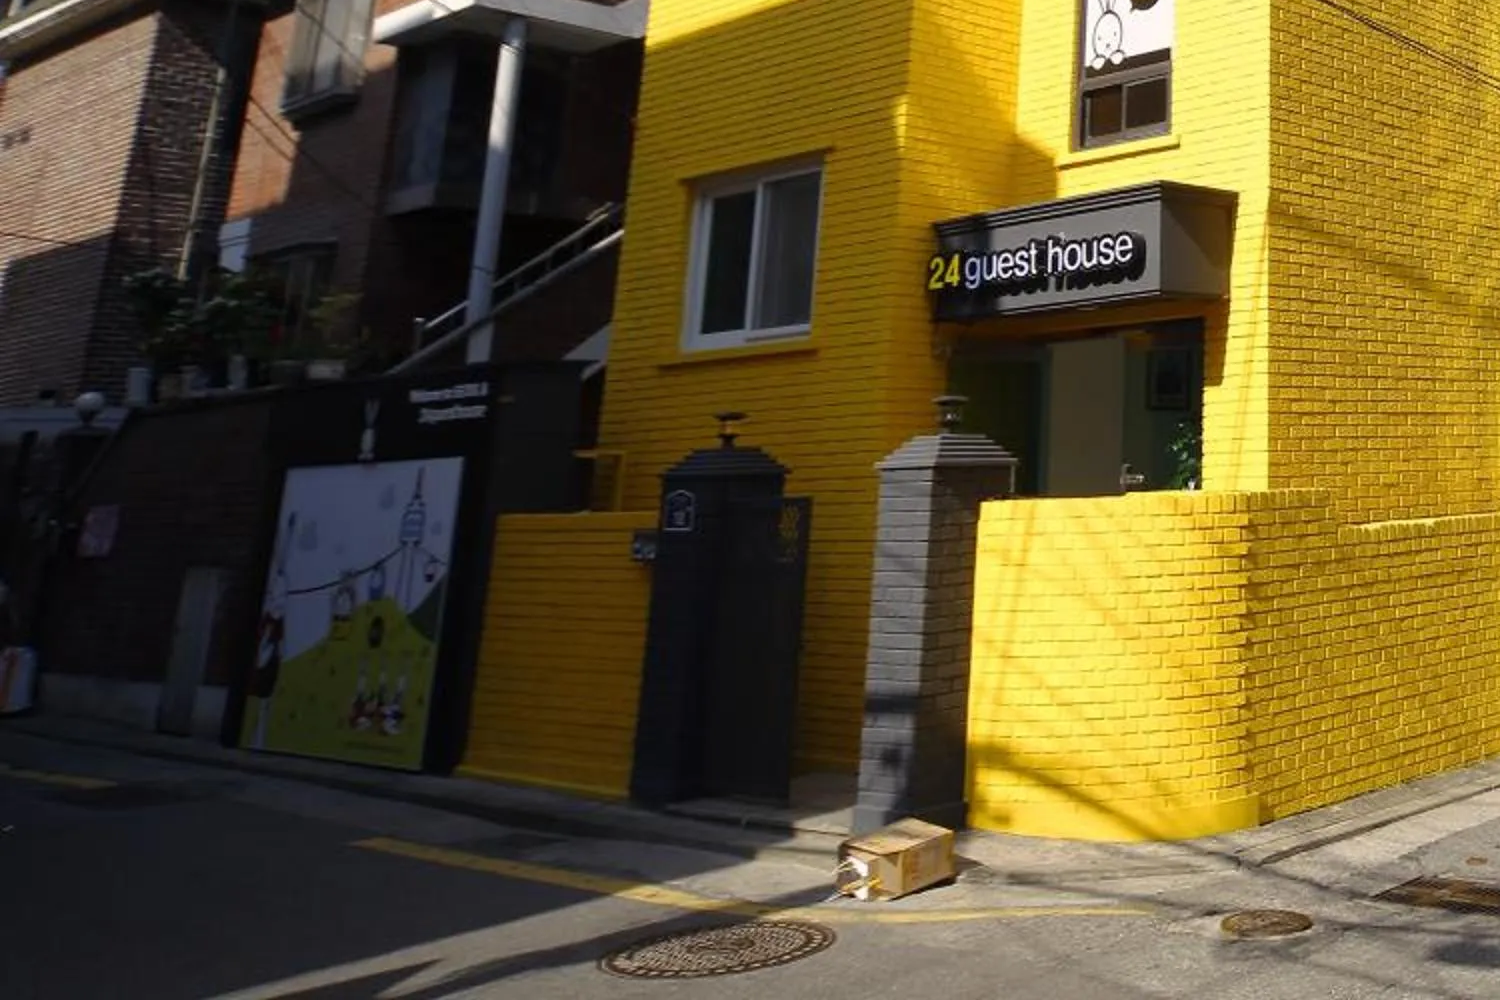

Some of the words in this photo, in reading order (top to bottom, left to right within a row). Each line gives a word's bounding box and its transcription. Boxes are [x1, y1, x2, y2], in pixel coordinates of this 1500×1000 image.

[927, 252, 962, 291] 24
[964, 241, 1038, 290] guest
[1046, 233, 1134, 274] house
